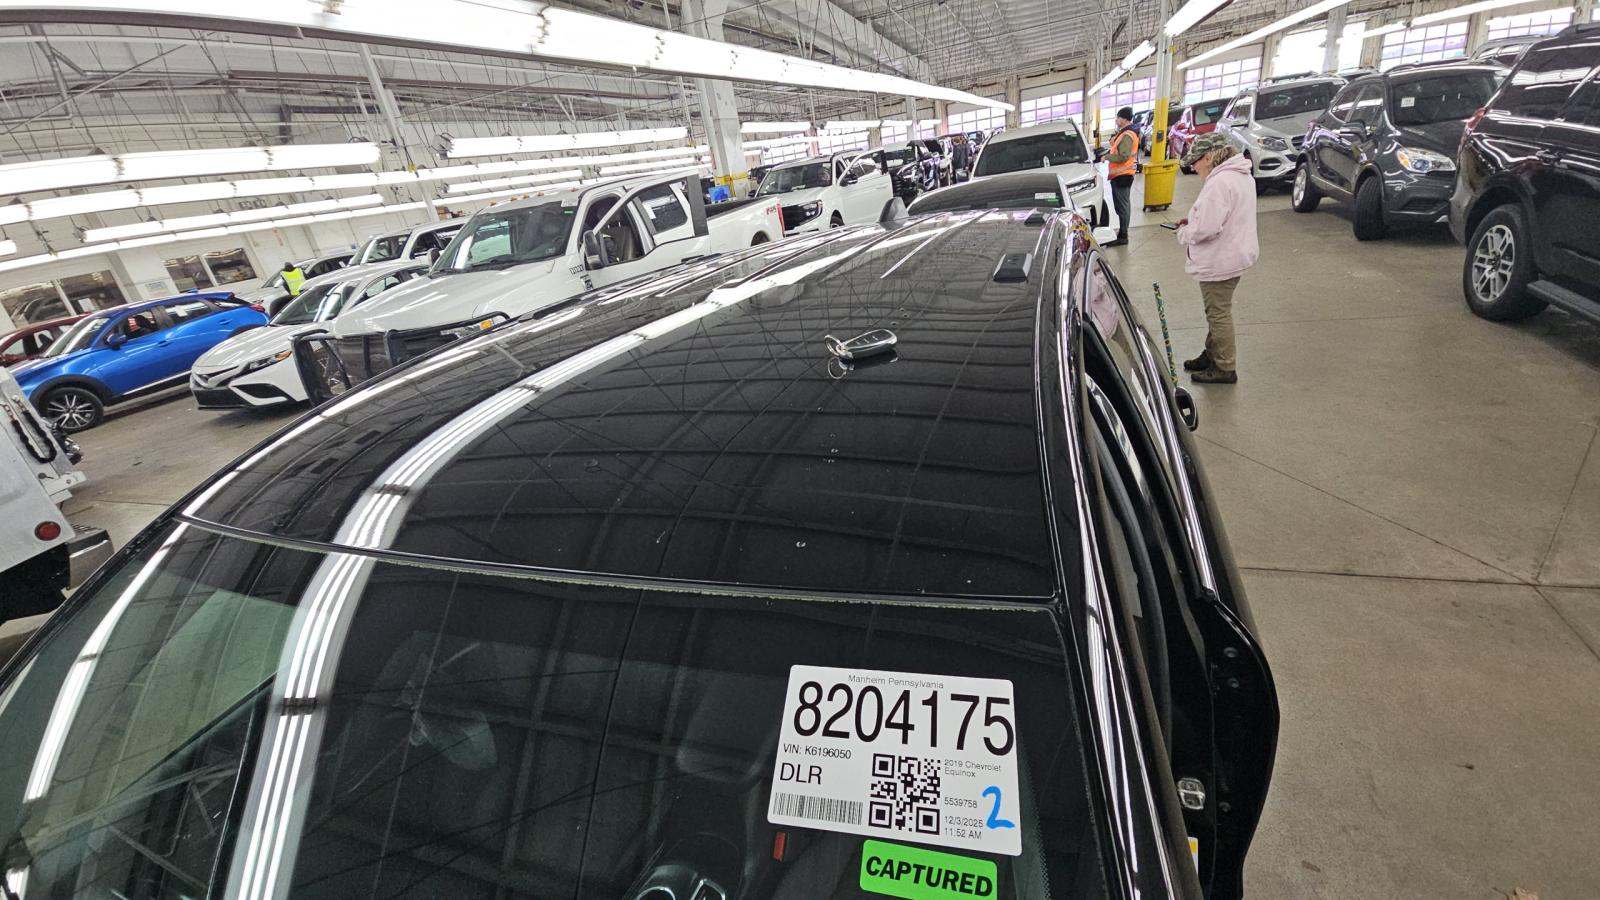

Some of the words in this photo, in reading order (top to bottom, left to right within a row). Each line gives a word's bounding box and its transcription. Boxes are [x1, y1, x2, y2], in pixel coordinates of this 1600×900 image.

[848, 674, 886, 685] Manheim
[888, 677, 944, 689] Pennsylvania
[793, 681, 1014, 756] 8204175
[783, 743, 802, 754] VIN:
[804, 745, 852, 759] K6196050
[944, 759, 963, 767] 2019
[965, 760, 1002, 772] Chevrolet
[944, 767, 976, 778] Equinox
[780, 762, 822, 785] DLR
[944, 796, 978, 808] 5539758
[982, 786, 1015, 829] 2
[944, 815, 984, 828] 12/3/2025
[944, 827, 966, 838] 11:52
[968, 830, 982, 839] AM
[866, 855, 993, 897] CAPTURED
